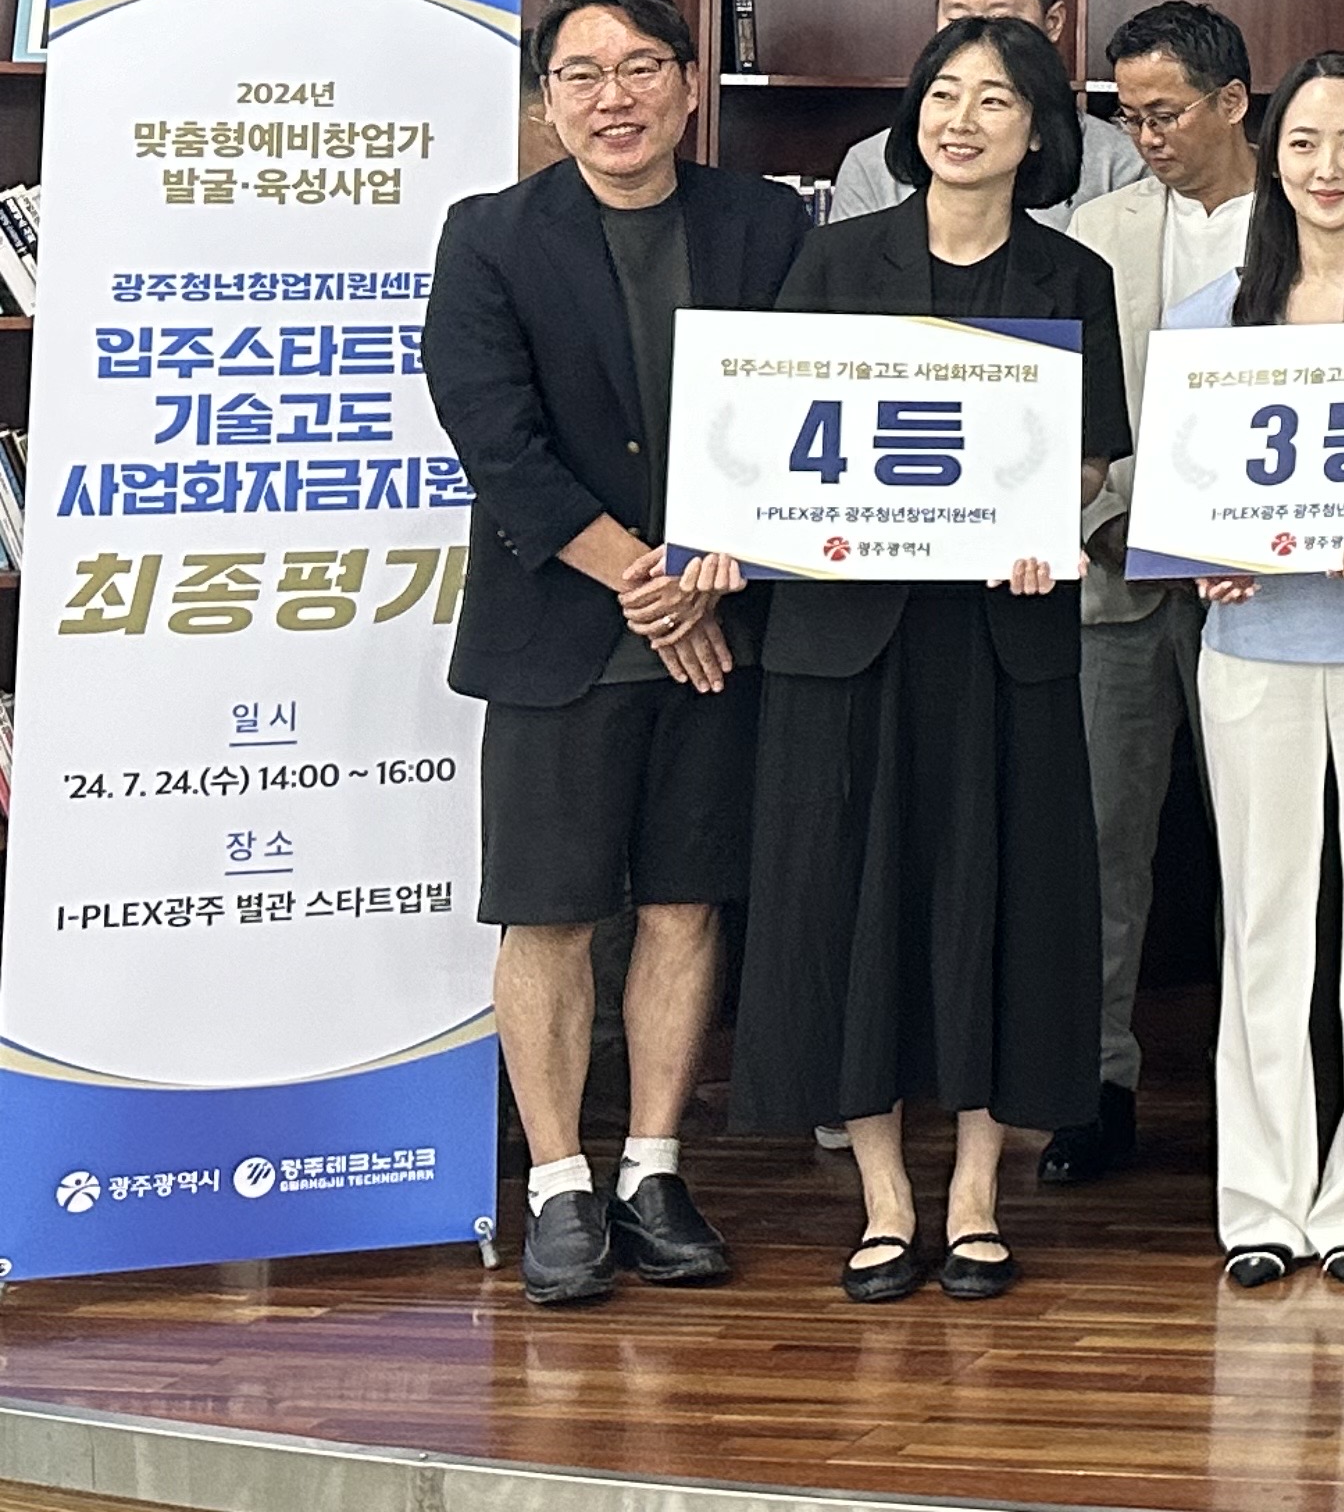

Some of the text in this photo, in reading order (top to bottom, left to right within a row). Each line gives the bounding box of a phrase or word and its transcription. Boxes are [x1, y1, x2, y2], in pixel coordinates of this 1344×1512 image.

[237, 81, 335, 107] 2024년
[135, 121, 435, 159] 맞춤형예비창업가
[163, 168, 401, 205] 발굴·육성사업
[721, 358, 1038, 382] 입주스타트업 기술고도 사업화자금지원
[1188, 371, 1287, 389] 입주스타트업
[154, 392, 393, 445] 기술고도
[57, 458, 475, 516] 사업화자금지원
[757, 507, 996, 524] I-PLEX광주 광주청년창업지원센터
[1212, 505, 1288, 520] I-PLEX광주
[58, 547, 470, 635] 최종평가
[259, 764, 339, 790] 14:00
[377, 758, 455, 784] 16:00
[58, 882, 451, 930] I-PLEX광주 별관 스타트업빌
[109, 1148, 436, 1200] 광주광역시 광주테크노파크
